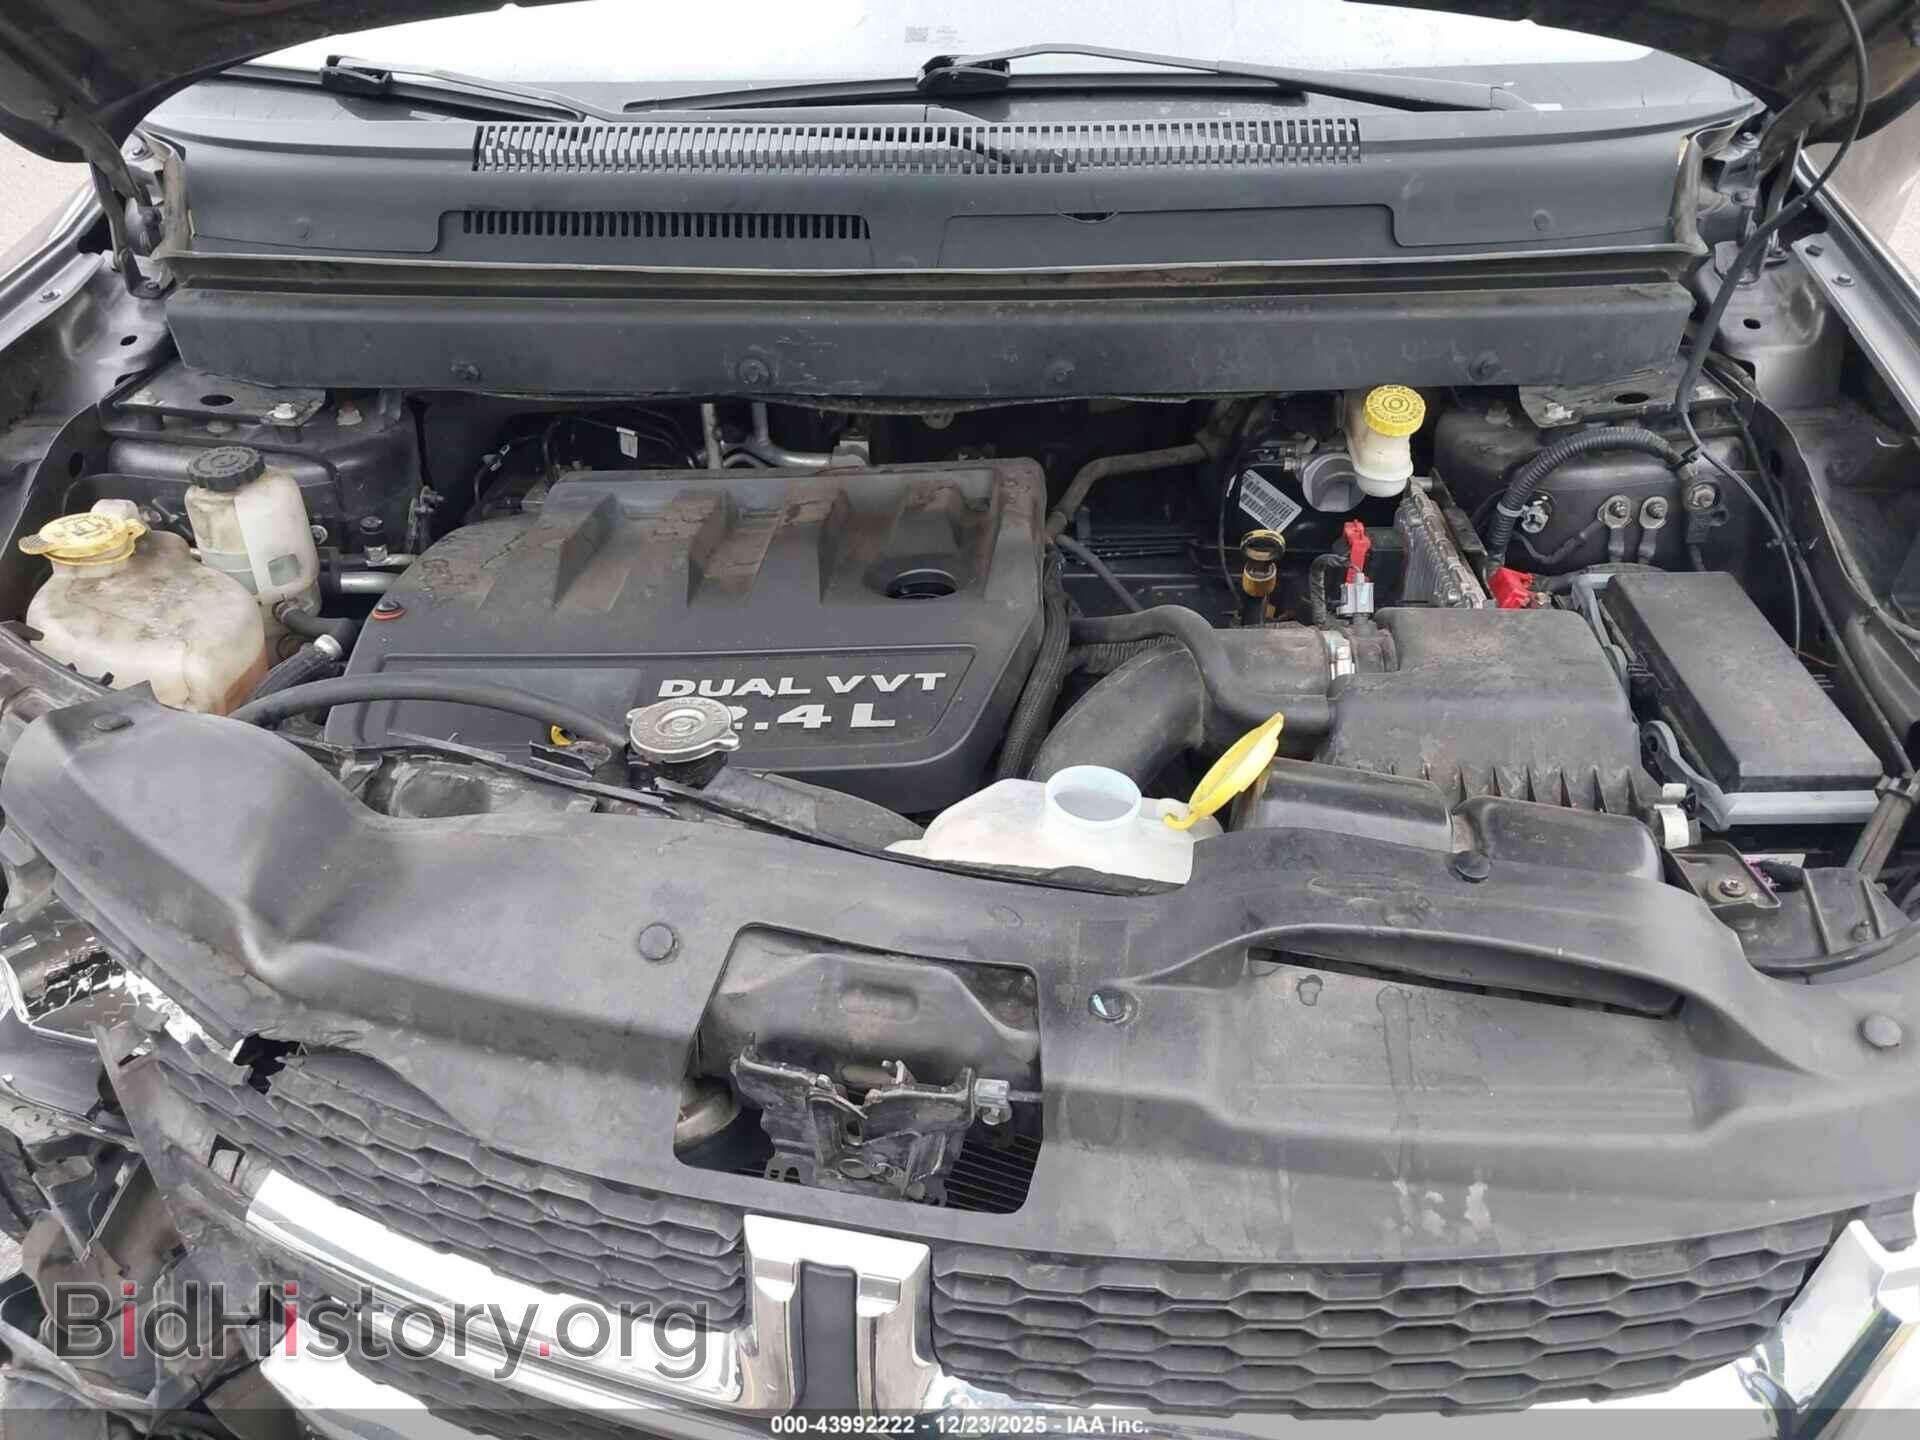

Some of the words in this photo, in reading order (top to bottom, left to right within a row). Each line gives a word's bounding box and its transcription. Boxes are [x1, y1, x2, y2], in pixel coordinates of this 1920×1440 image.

[658, 677, 811, 697] DUAL
[826, 672, 946, 692] VVT
[850, 703, 896, 728] L
